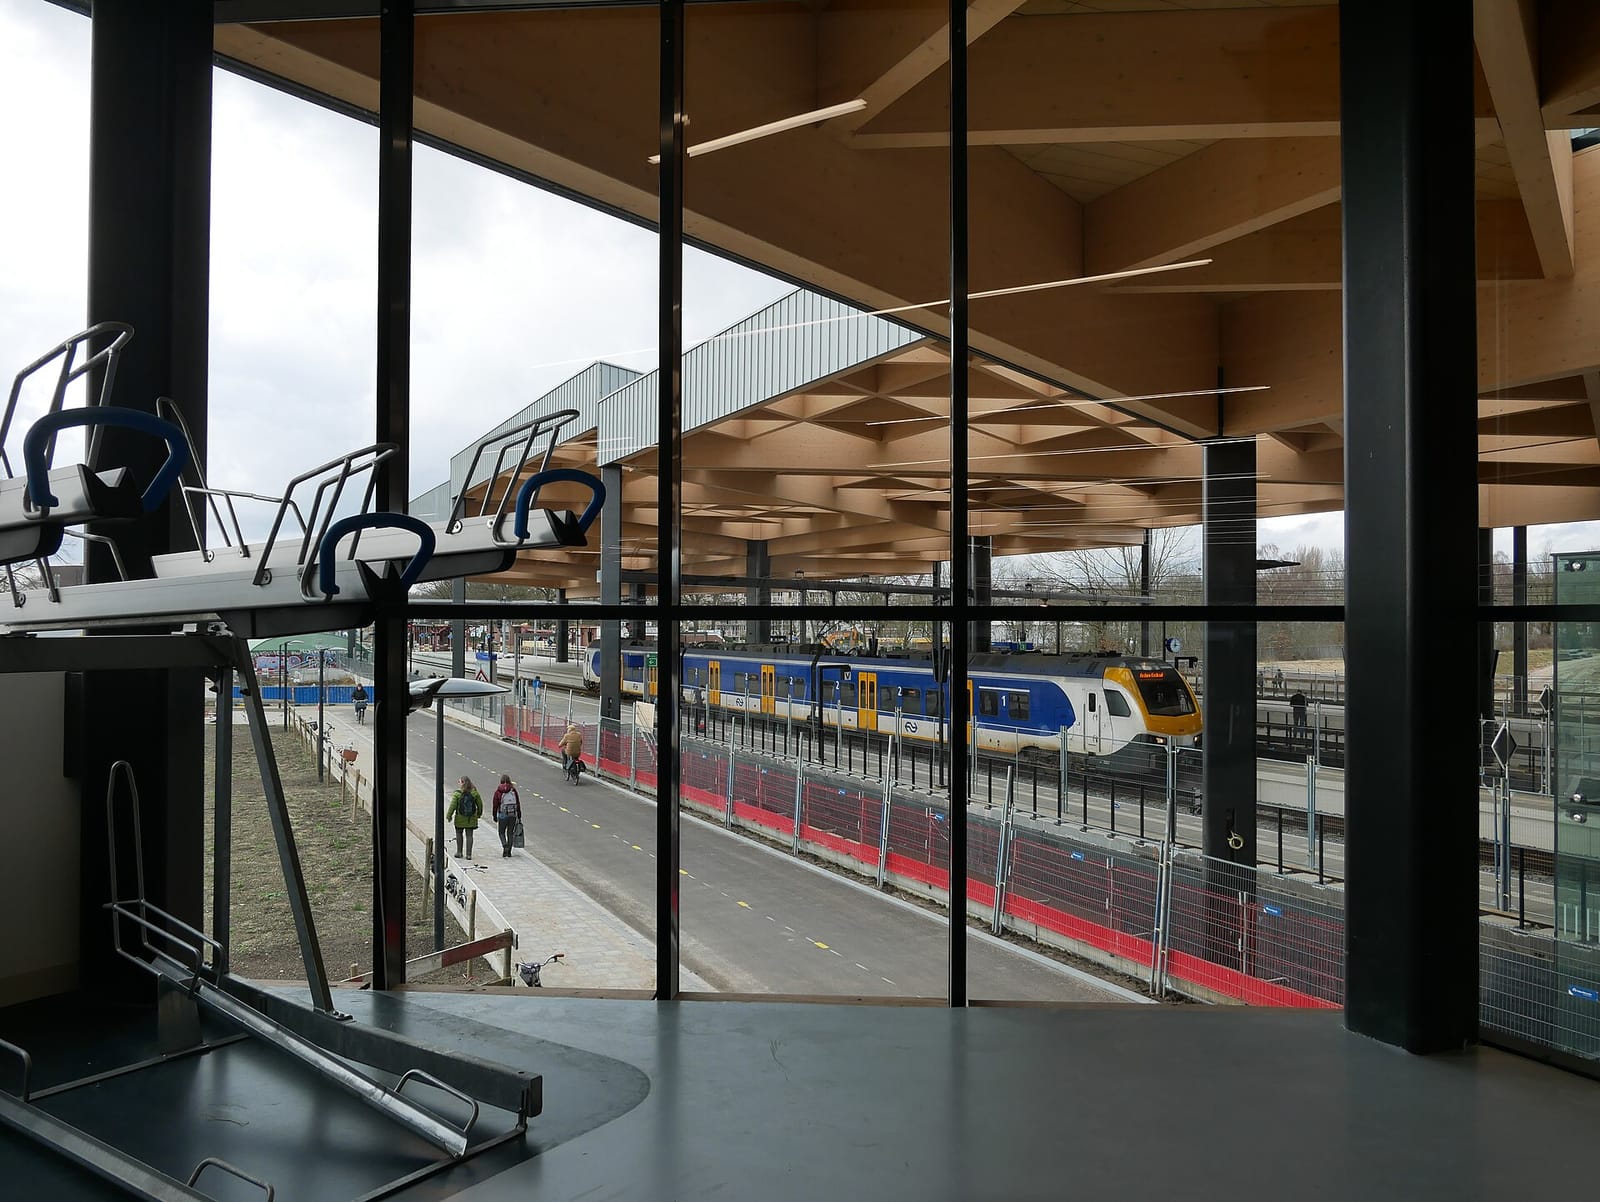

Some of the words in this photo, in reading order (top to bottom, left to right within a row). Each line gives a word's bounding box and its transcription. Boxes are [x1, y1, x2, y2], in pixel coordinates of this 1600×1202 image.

[835, 681, 840, 690] 2
[897, 686, 902, 696] 2
[1001, 695, 1006, 707] 1
